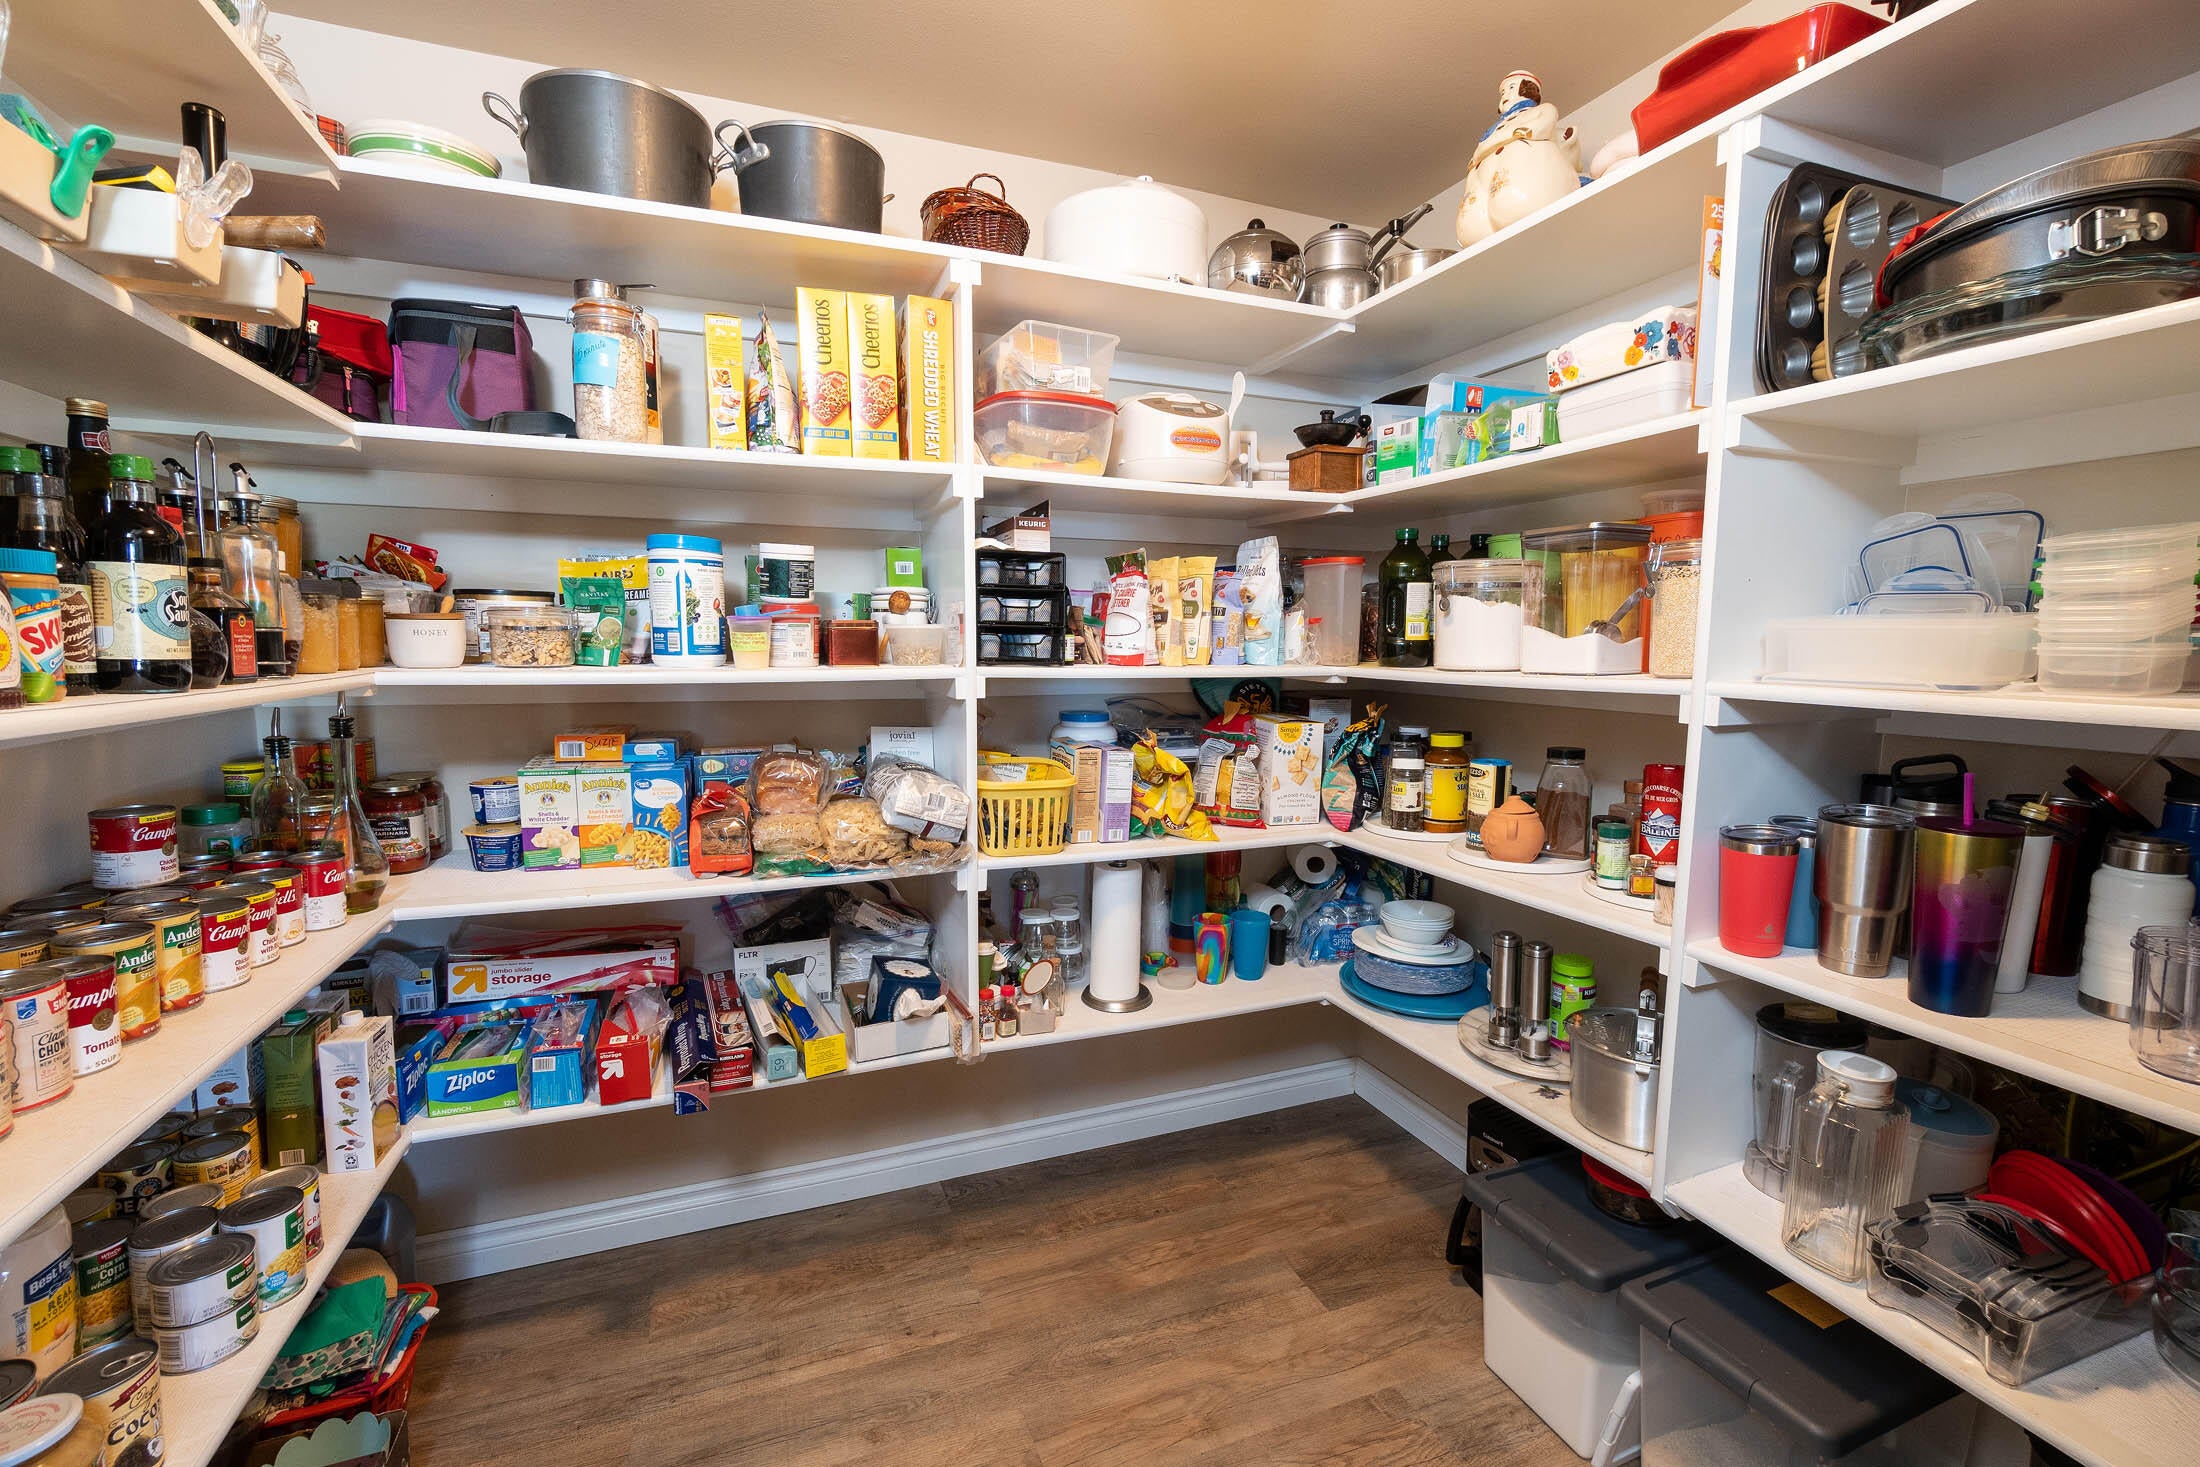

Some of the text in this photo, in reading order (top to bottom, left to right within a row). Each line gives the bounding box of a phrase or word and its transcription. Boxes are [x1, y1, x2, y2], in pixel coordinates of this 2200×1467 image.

[815, 299, 832, 366] Cheerios
[861, 303, 881, 369] Cheerios
[923, 330, 940, 459] SHREDDED WHEAT
[1018, 520, 1047, 528] KEURIG
[171, 590, 189, 609] Soy
[624, 589, 650, 600] REAME
[61, 615, 92, 629] oconut
[412, 628, 448, 637] HONEY
[1239, 683, 1267, 694] SIETE
[889, 731, 916, 742] jovial
[1279, 726, 1300, 735] Simple
[1454, 771, 1467, 782] Jo
[524, 778, 571, 795] Annie's
[581, 776, 627, 792] Annie's
[1649, 785, 1670, 793] COARSE
[1466, 831, 1480, 840] ARS
[1641, 822, 1680, 837] BALEINE
[738, 951, 758, 959] FLTR
[491, 973, 552, 985] storage
[367, 1036, 393, 1068] CHICKEN
[600, 1051, 622, 1060] storage
[675, 1022, 692, 1075] Reynolds Wrap
[95, 1054, 117, 1068] SOUP
[719, 1053, 745, 1061] KIRKLAND
[713, 1063, 750, 1073] Parchment Paper
[774, 1058, 785, 1072] 65
[405, 1057, 429, 1095] Ziploc
[446, 1068, 496, 1093] Ziploc
[503, 1099, 517, 1107] 125
[431, 1105, 472, 1117] SANDWICH
[87, 1261, 114, 1275] GOLDEN
[100, 1261, 126, 1280] Corn
[28, 1271, 58, 1296] Best
[48, 1286, 73, 1313] REAL
